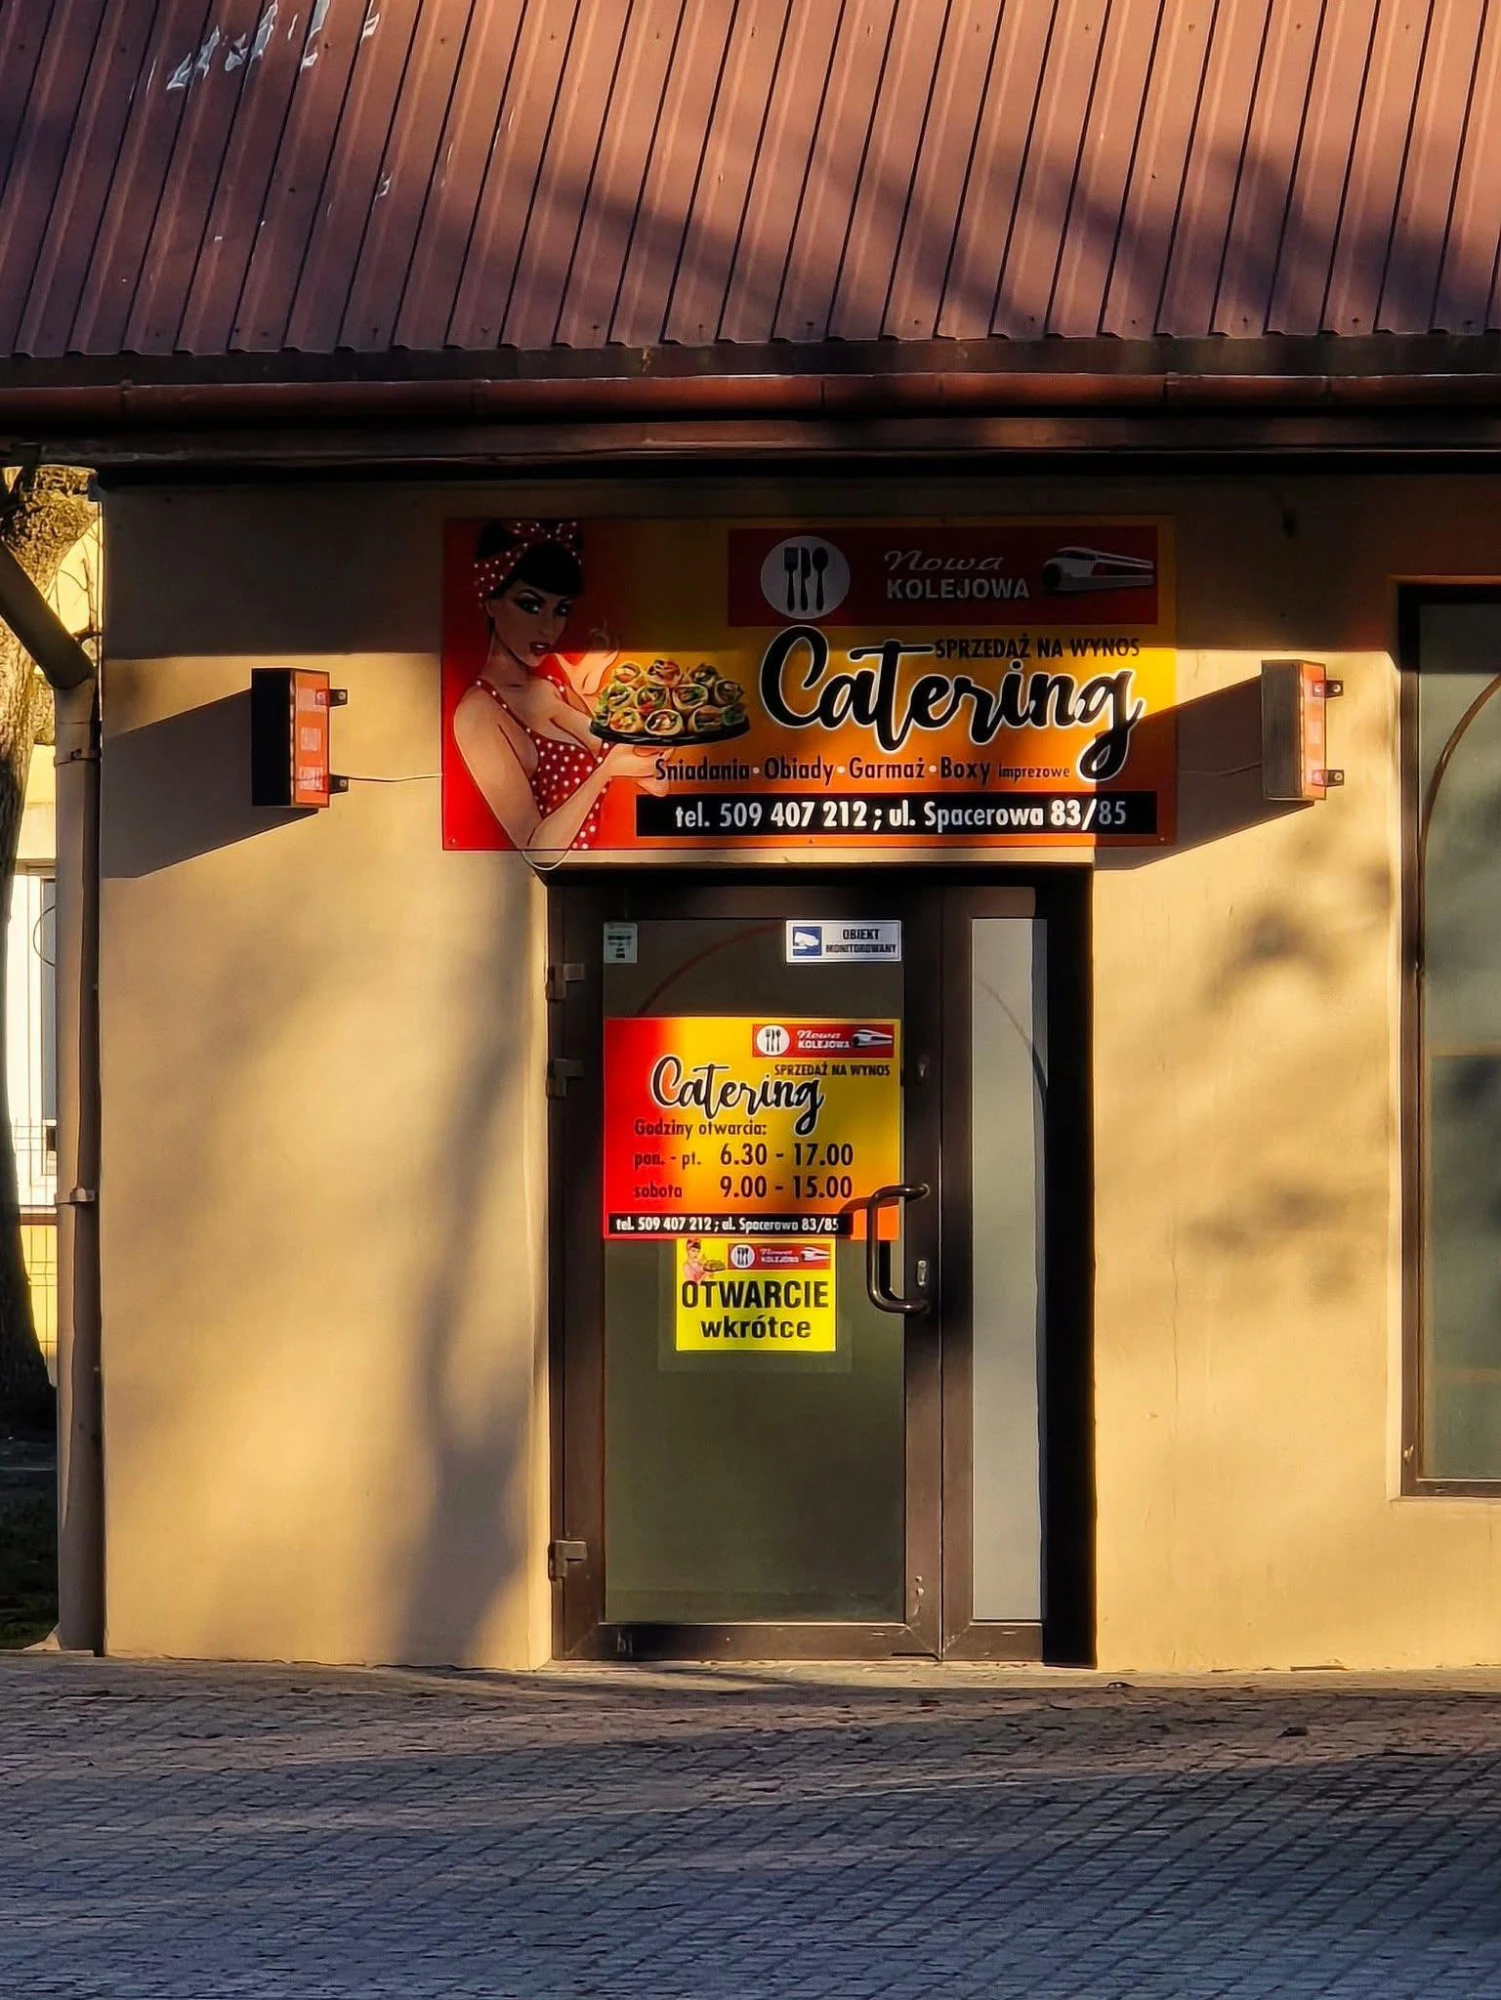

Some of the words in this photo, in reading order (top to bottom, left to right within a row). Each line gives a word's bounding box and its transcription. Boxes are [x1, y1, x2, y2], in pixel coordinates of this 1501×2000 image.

[884, 550, 1004, 572] Nowa
[887, 577, 1030, 599] KOLEJOWA
[935, 633, 1030, 658] SPRZEDAŻ
[1037, 639, 1063, 658] NA
[1070, 638, 1140, 657] WYNOS
[762, 625, 1143, 780] Catering
[655, 755, 750, 780] Śniadania
[764, 756, 834, 785] Obiady
[849, 756, 925, 779] Garmaż
[941, 756, 990, 785] Boxy
[999, 763, 1070, 782] imprezowe
[675, 801, 710, 827] tel.
[719, 803, 762, 827] 509
[770, 801, 815, 827] 407
[889, 800, 916, 826] ul.
[924, 801, 1044, 833] Spacerowa
[1050, 798, 1126, 831] 83/85
[843, 929, 880, 940] OBIEKT
[798, 1040, 850, 1049] KOLEJOWA
[774, 1061, 828, 1076] SPRZEDAŻ
[832, 1064, 847, 1076] NA
[850, 1064, 890, 1076] WYNOS
[652, 1055, 825, 1136] Catering
[634, 1119, 693, 1139] Godziny
[698, 1120, 767, 1136] otwarcia:
[634, 1153, 665, 1170] pon.
[682, 1152, 701, 1170] pt.
[720, 1143, 767, 1166] 6.30
[793, 1143, 853, 1166] 17.00
[634, 1182, 683, 1198] sobota
[720, 1176, 767, 1198] 9.00
[793, 1176, 852, 1198] 15.00
[616, 1217, 634, 1231] tel.
[638, 1217, 660, 1231] 509
[663, 1217, 686, 1231] 407
[739, 1217, 799, 1235] Spacerowa
[801, 1217, 839, 1233] 83/85
[682, 1280, 829, 1308] OTWARCIE
[701, 1314, 811, 1339] wkrótce
